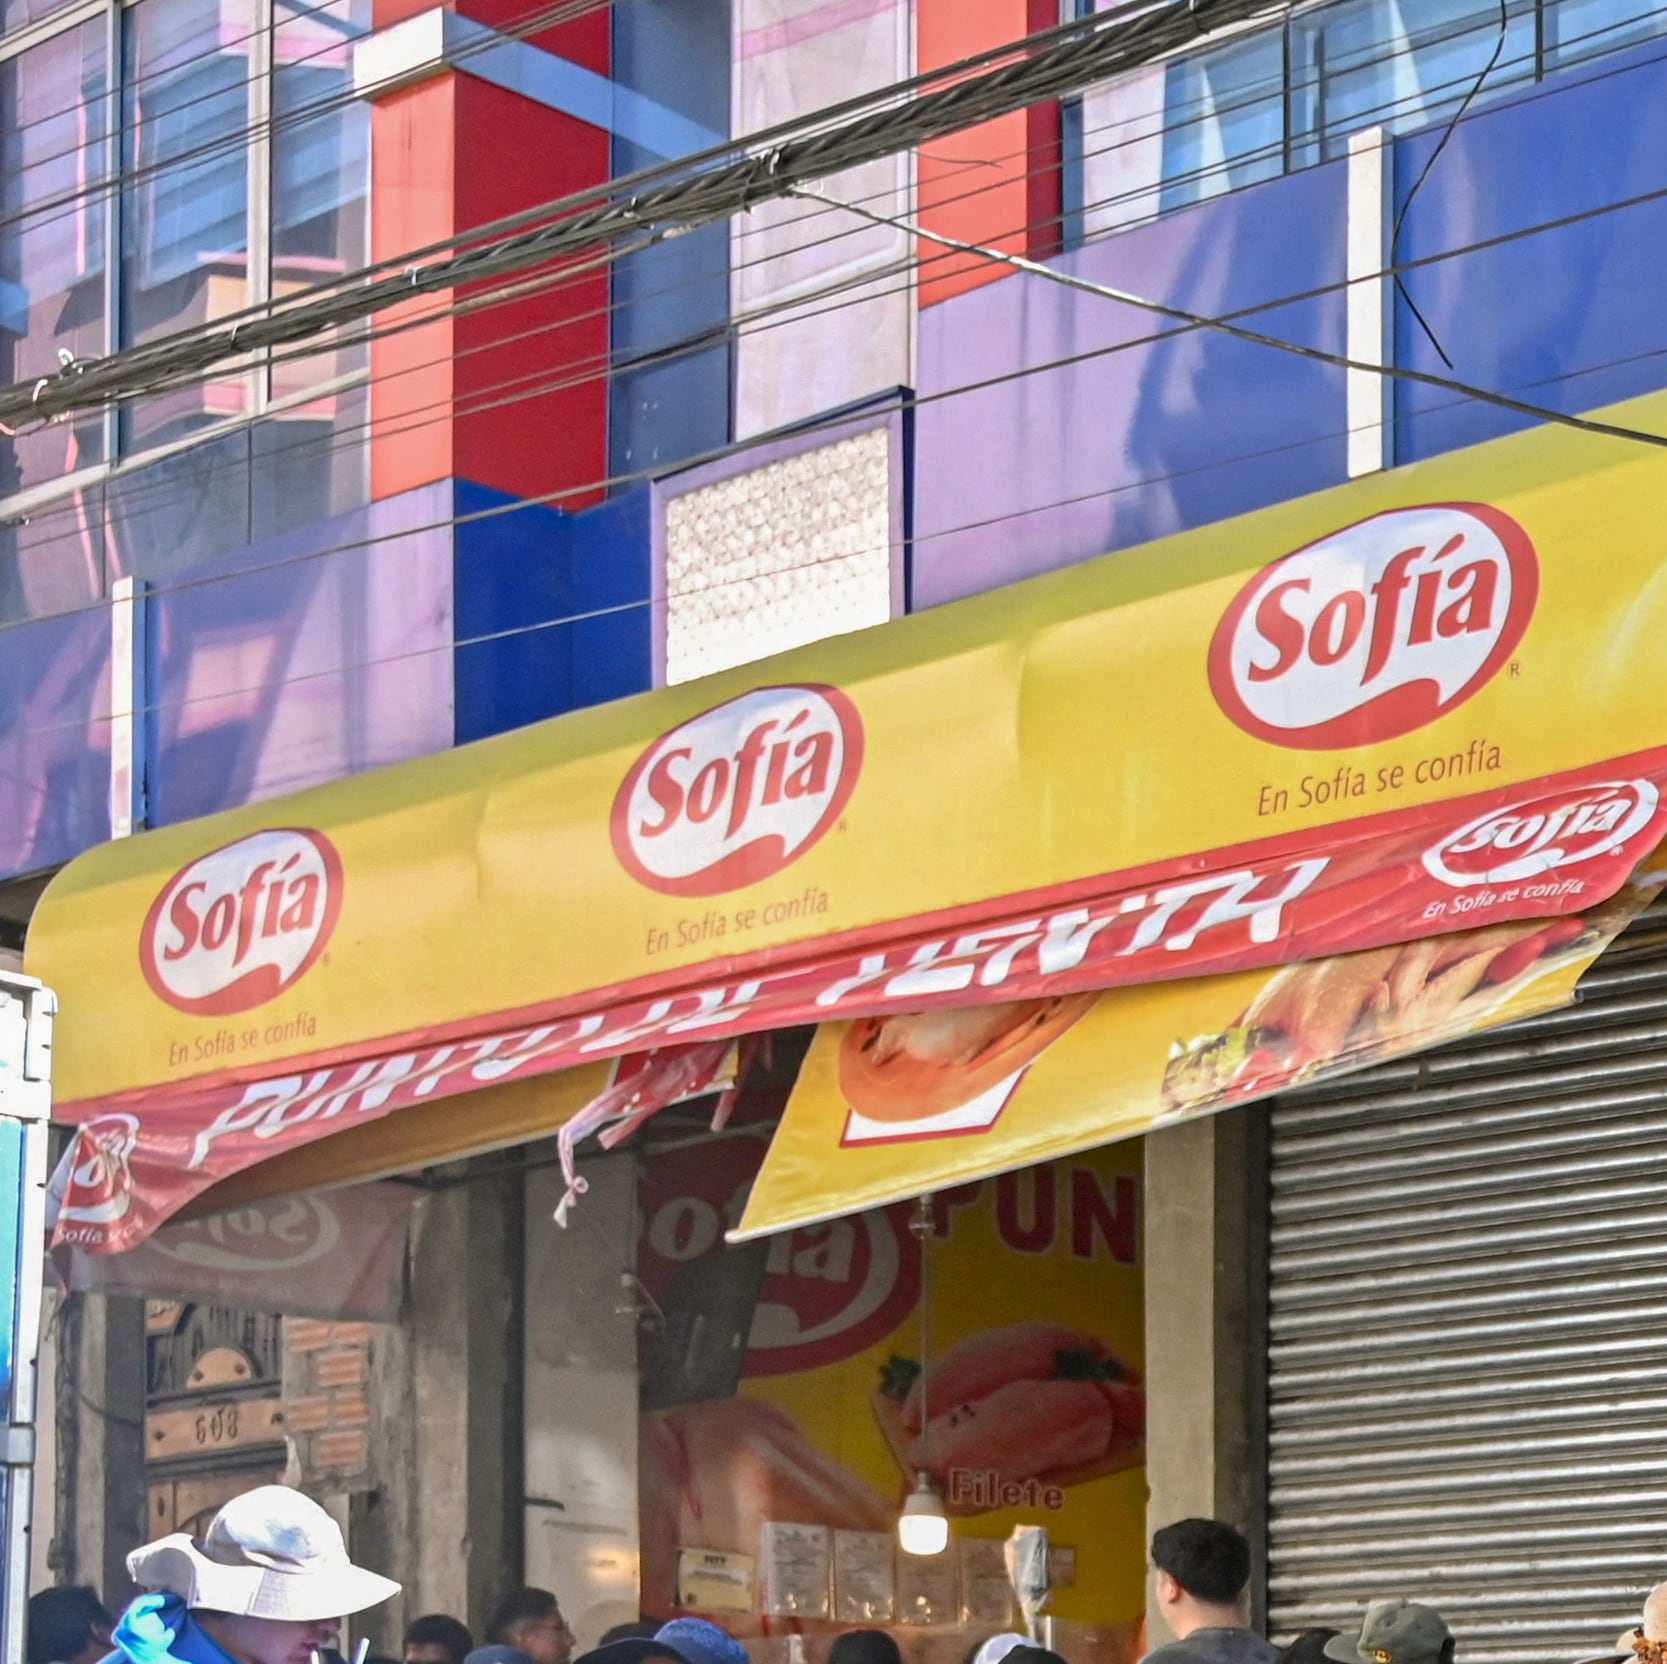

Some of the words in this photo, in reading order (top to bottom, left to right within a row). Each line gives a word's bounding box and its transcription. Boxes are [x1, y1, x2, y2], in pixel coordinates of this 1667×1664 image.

[1247, 532, 1500, 687] Sofía
[639, 708, 835, 842] Sofía
[1258, 785, 1288, 816] En
[1299, 766, 1365, 808] Sofía
[1376, 766, 1404, 792] se
[1415, 739, 1501, 784] confía
[1449, 789, 1633, 860] Sofía
[163, 851, 320, 969] Sofía
[645, 927, 669, 955] En
[676, 911, 727, 948] Sofía
[735, 911, 756, 932] se
[763, 886, 828, 926] confía
[1422, 900, 1446, 919] En
[1452, 891, 1496, 916] Sofía
[168, 1041, 189, 1067] En
[194, 1029, 236, 1059] Sofía
[241, 1030, 258, 1049] se
[264, 1012, 317, 1046] confía
[948, 1467, 1066, 1513] Filete
